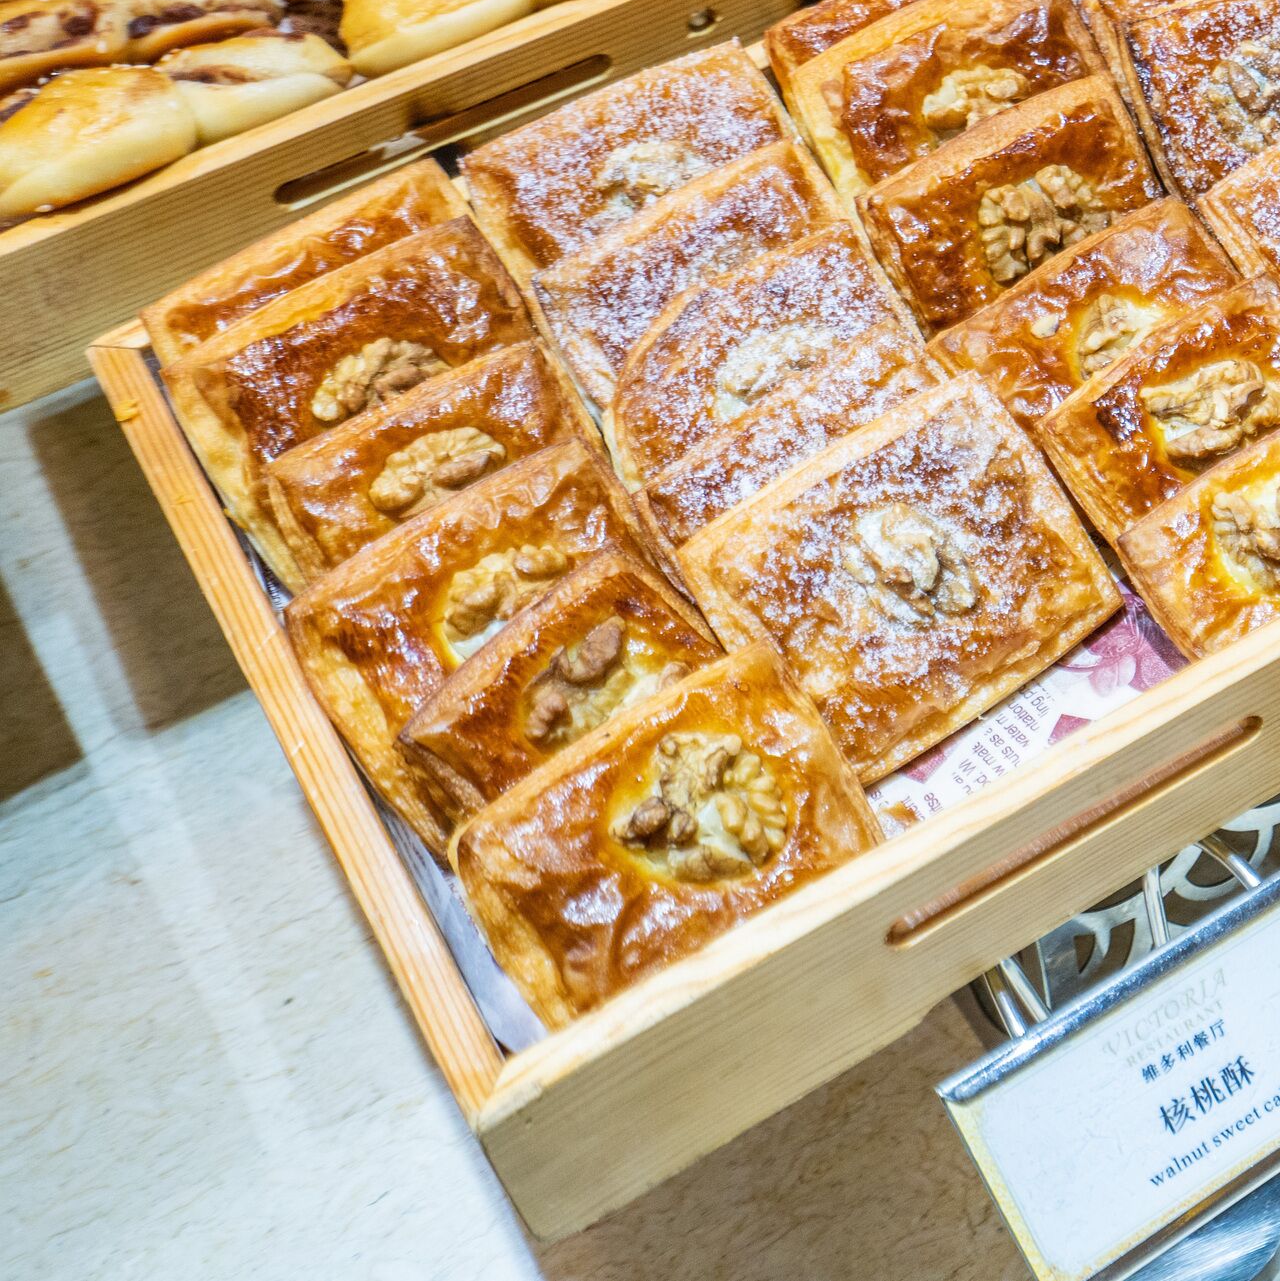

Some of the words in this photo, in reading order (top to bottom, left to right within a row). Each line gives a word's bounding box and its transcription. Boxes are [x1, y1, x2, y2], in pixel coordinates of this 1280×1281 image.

[1103, 968, 1227, 1056] VICTORIA
[1126, 1000, 1225, 1066] RESTAURANT
[1142, 1020, 1224, 1080] 维多利餐厅
[1160, 1056, 1254, 1134] 核桃酥
[1150, 1142, 1209, 1185] walnut
[1213, 1108, 1260, 1147] sweet
